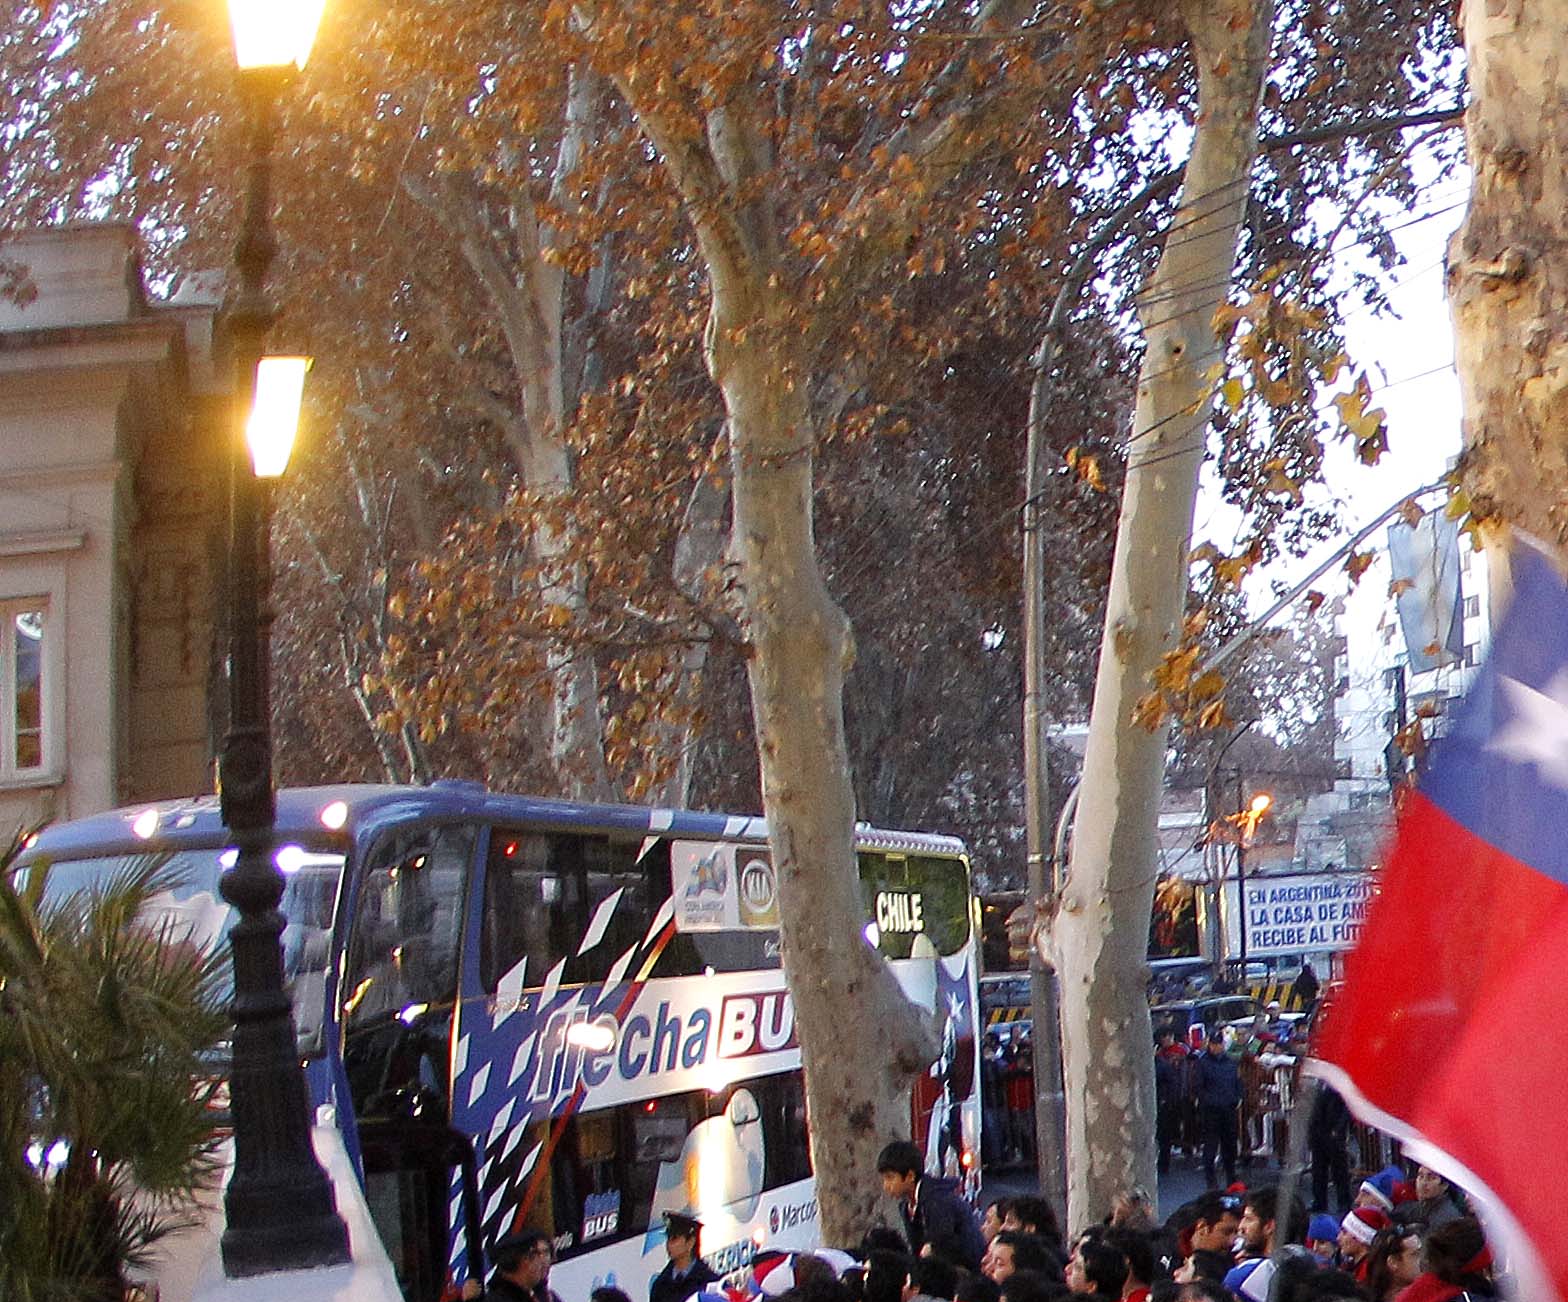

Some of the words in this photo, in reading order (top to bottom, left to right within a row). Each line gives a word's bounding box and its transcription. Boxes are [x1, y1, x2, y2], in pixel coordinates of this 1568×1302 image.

[1270, 883, 1342, 903] ARGENTINA
[877, 891, 924, 933] CHILE
[1251, 908, 1269, 926] LA
[1274, 905, 1314, 925] CASA
[1318, 903, 1338, 921] DE
[1252, 926, 1305, 948] RECIBE
[1309, 925, 1329, 944] AL
